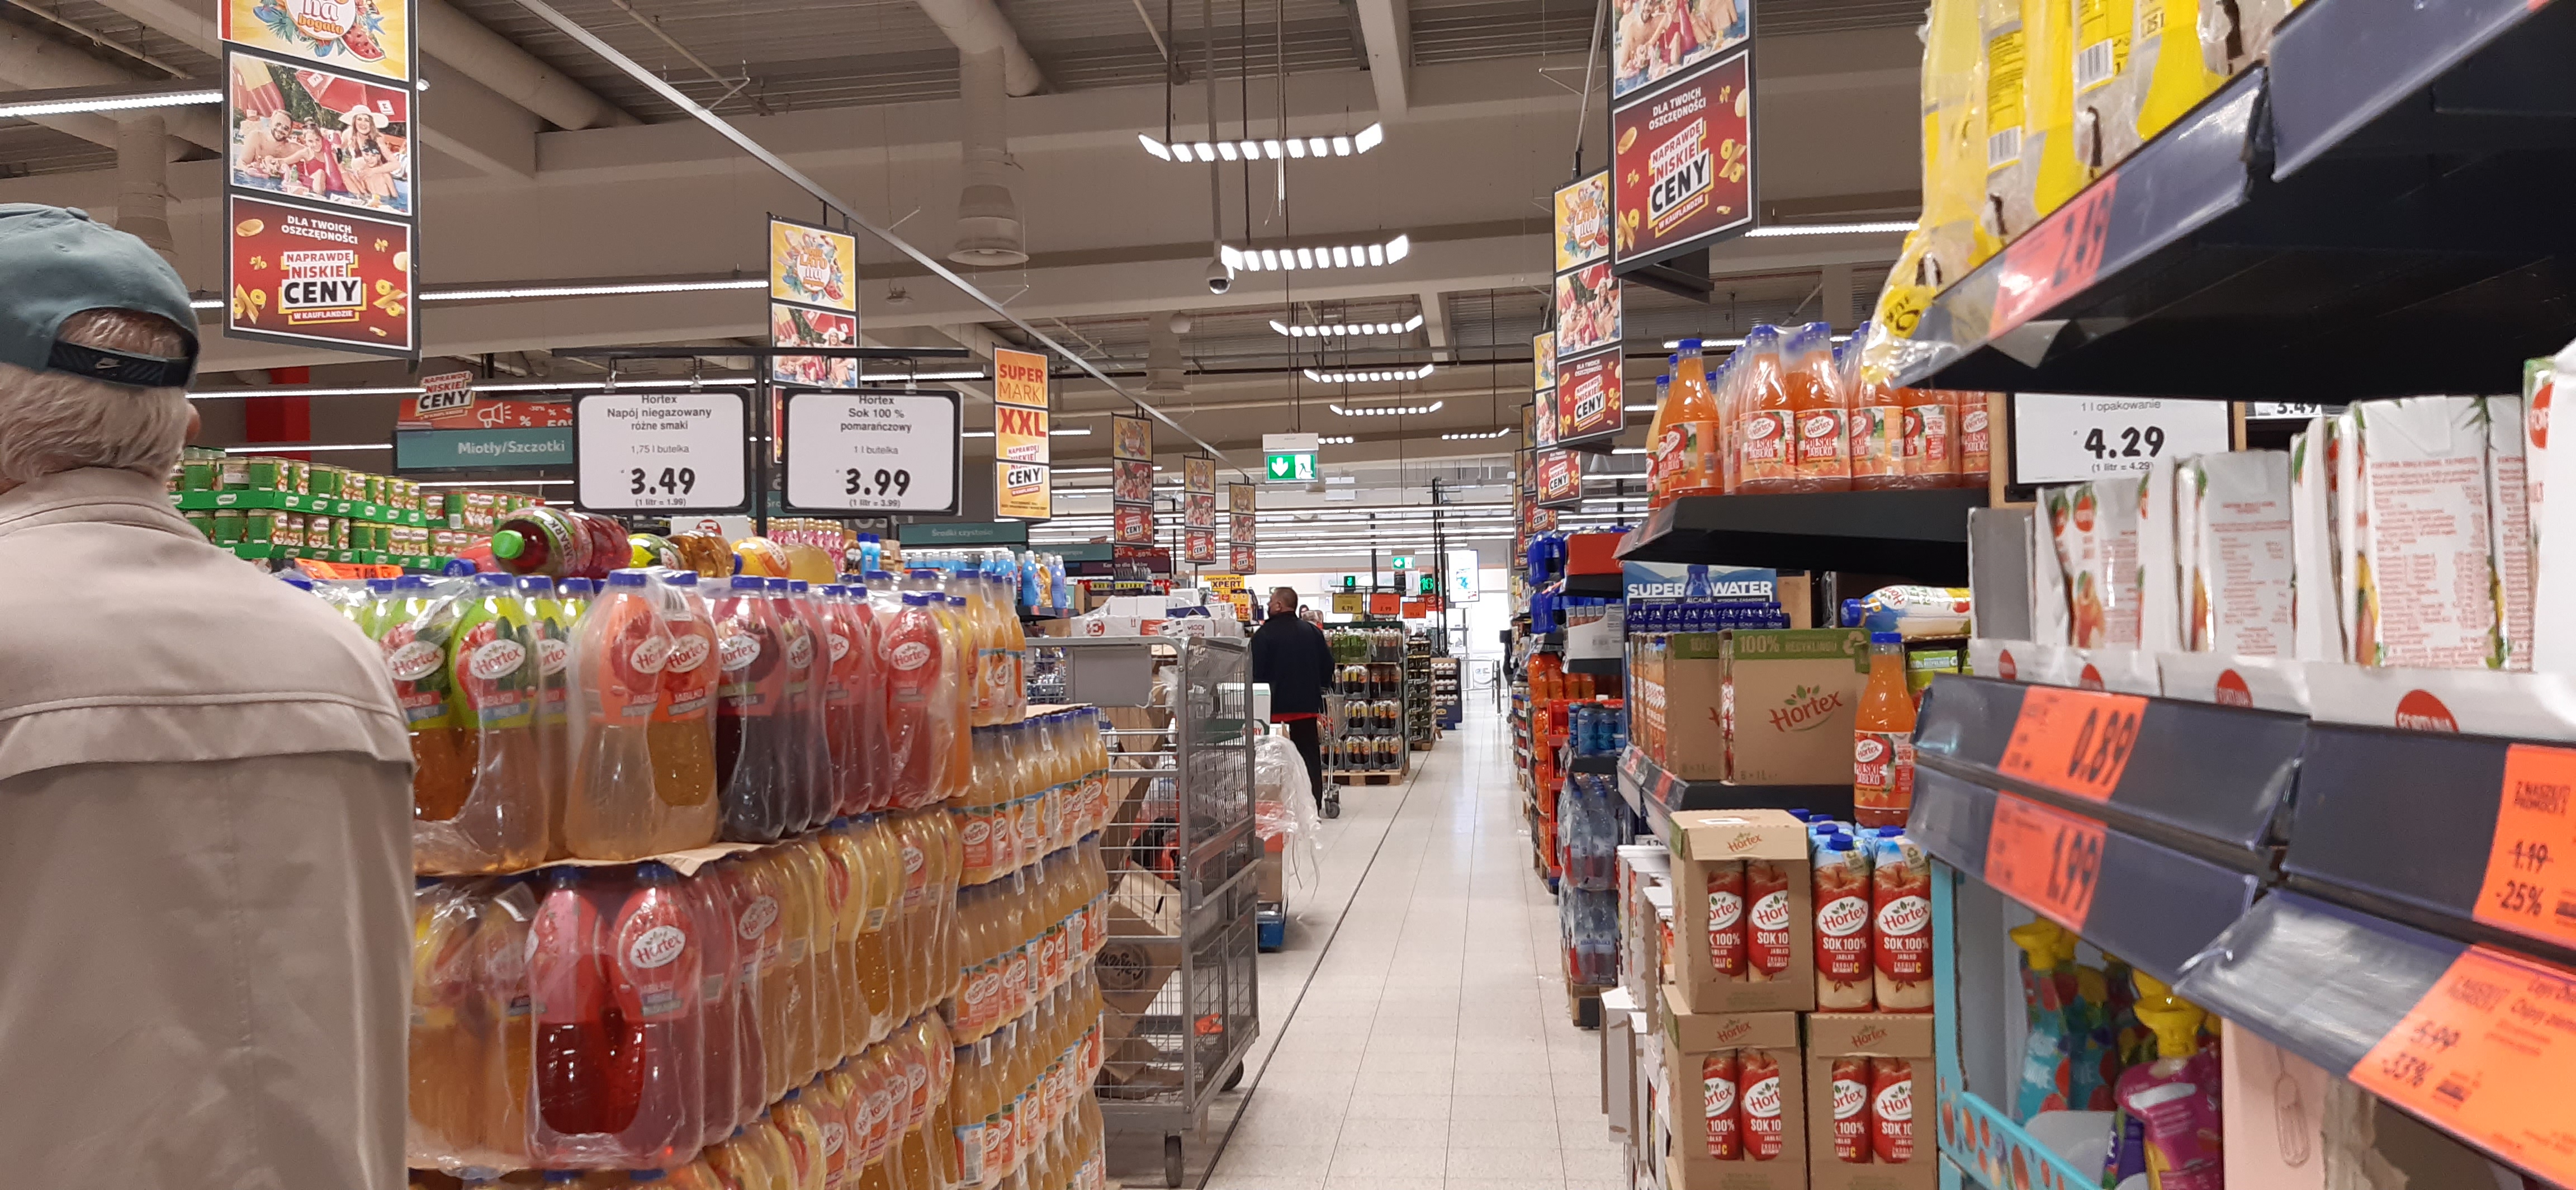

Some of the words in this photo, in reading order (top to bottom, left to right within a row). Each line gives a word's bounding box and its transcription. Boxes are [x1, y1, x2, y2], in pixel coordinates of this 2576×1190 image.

[298, 12, 344, 35] bogato
[1652, 101, 1669, 117] DLA
[1670, 86, 1702, 109] TWOICH
[1648, 98, 1707, 131] OSZCZĘDNOŚCI
[1652, 125, 1701, 163] NAPRAWDĘ
[1656, 141, 1696, 181] NISKIE
[1652, 152, 1709, 213] CENY
[1665, 197, 1704, 226] KAUFLANDZIE
[288, 215, 309, 226] DLA
[311, 219, 352, 233] TWOICH
[281, 225, 358, 244] OSZCZĘDNOŚCI
[287, 253, 351, 263] NAPRAWDĘ
[292, 265, 344, 278] NISKIE
[284, 280, 359, 304] CENY
[302, 310, 353, 319] KAUFLANDZIE
[999, 364, 1044, 383] SUPER
[426, 381, 462, 393] NISKIE
[999, 381, 1045, 403] MARKI
[420, 390, 471, 409] CENY
[642, 395, 678, 404] Hortex
[859, 395, 894, 404] Hortex
[1576, 393, 1603, 418] CENY
[2095, 399, 2161, 414] opakowanie
[607, 408, 639, 419] Napój
[642, 408, 712, 418] niegazowany
[849, 408, 869, 417] Sok
[874, 409, 892, 418] 100
[894, 409, 905, 418] %
[631, 421, 658, 430] różne
[661, 421, 688, 430] smaki
[841, 422, 912, 433] pomarańczowy
[1000, 408, 1046, 437] XXL
[1807, 421, 1831, 435] Hortex
[458, 440, 565, 456] Miotły/Szczotki
[632, 446, 650, 455] 1,75
[866, 446, 899, 455] butelka
[1805, 438, 1835, 448] POLSKIE
[2083, 427, 2165, 459] 4.29
[1807, 447, 1833, 457] JABŁKO
[2091, 462, 2103, 474] (1
[2105, 463, 2118, 473] litr
[2129, 462, 2154, 473] 4.29)
[631, 468, 695, 495] 3.49
[845, 468, 911, 497] 3.99
[1008, 468, 1040, 485] CENY
[1550, 474, 1568, 490] CENY
[667, 498, 686, 507] 1.99)
[1533, 514, 1546, 525] CENY
[1126, 525, 1142, 534] CENY
[1627, 584, 1685, 596] SUPER
[1711, 581, 1773, 595] WATER
[1739, 635, 1780, 653] 100%
[394, 651, 439, 674] Hortex
[475, 649, 522, 674] Hortex
[668, 644, 707, 668] Hortex
[894, 650, 927, 666] Hortex
[1769, 690, 1843, 732] Hortex
[1858, 747, 1878, 758] Hortex
[2068, 707, 2134, 786] 0.89
[1727, 834, 1762, 852] Hortex
[2496, 880, 2544, 917] -25%
[1757, 904, 1789, 925] Hort
[1822, 905, 1866, 931] Hortex
[1883, 904, 1929, 931] Hortex
[1716, 933, 1740, 945] 100%
[1757, 932, 1775, 944] SOK
[1777, 932, 1789, 944] 10
[1823, 937, 1841, 950] SOK
[1844, 937, 1867, 950] 100%
[1884, 937, 1903, 950] SOK
[1905, 937, 1929, 950] 100%
[636, 934, 681, 964] Hortex
[1716, 1021, 1751, 1042] Hortex
[1852, 1028, 1887, 1048] Hortex
[1711, 1120, 1735, 1132] 100%
[1751, 1120, 1769, 1131] SOK
[1771, 1120, 1781, 1131] 10
[1840, 1122, 1864, 1135] 100%
[1882, 1122, 1901, 1135] SOK
[1902, 1123, 1912, 1135] 10
